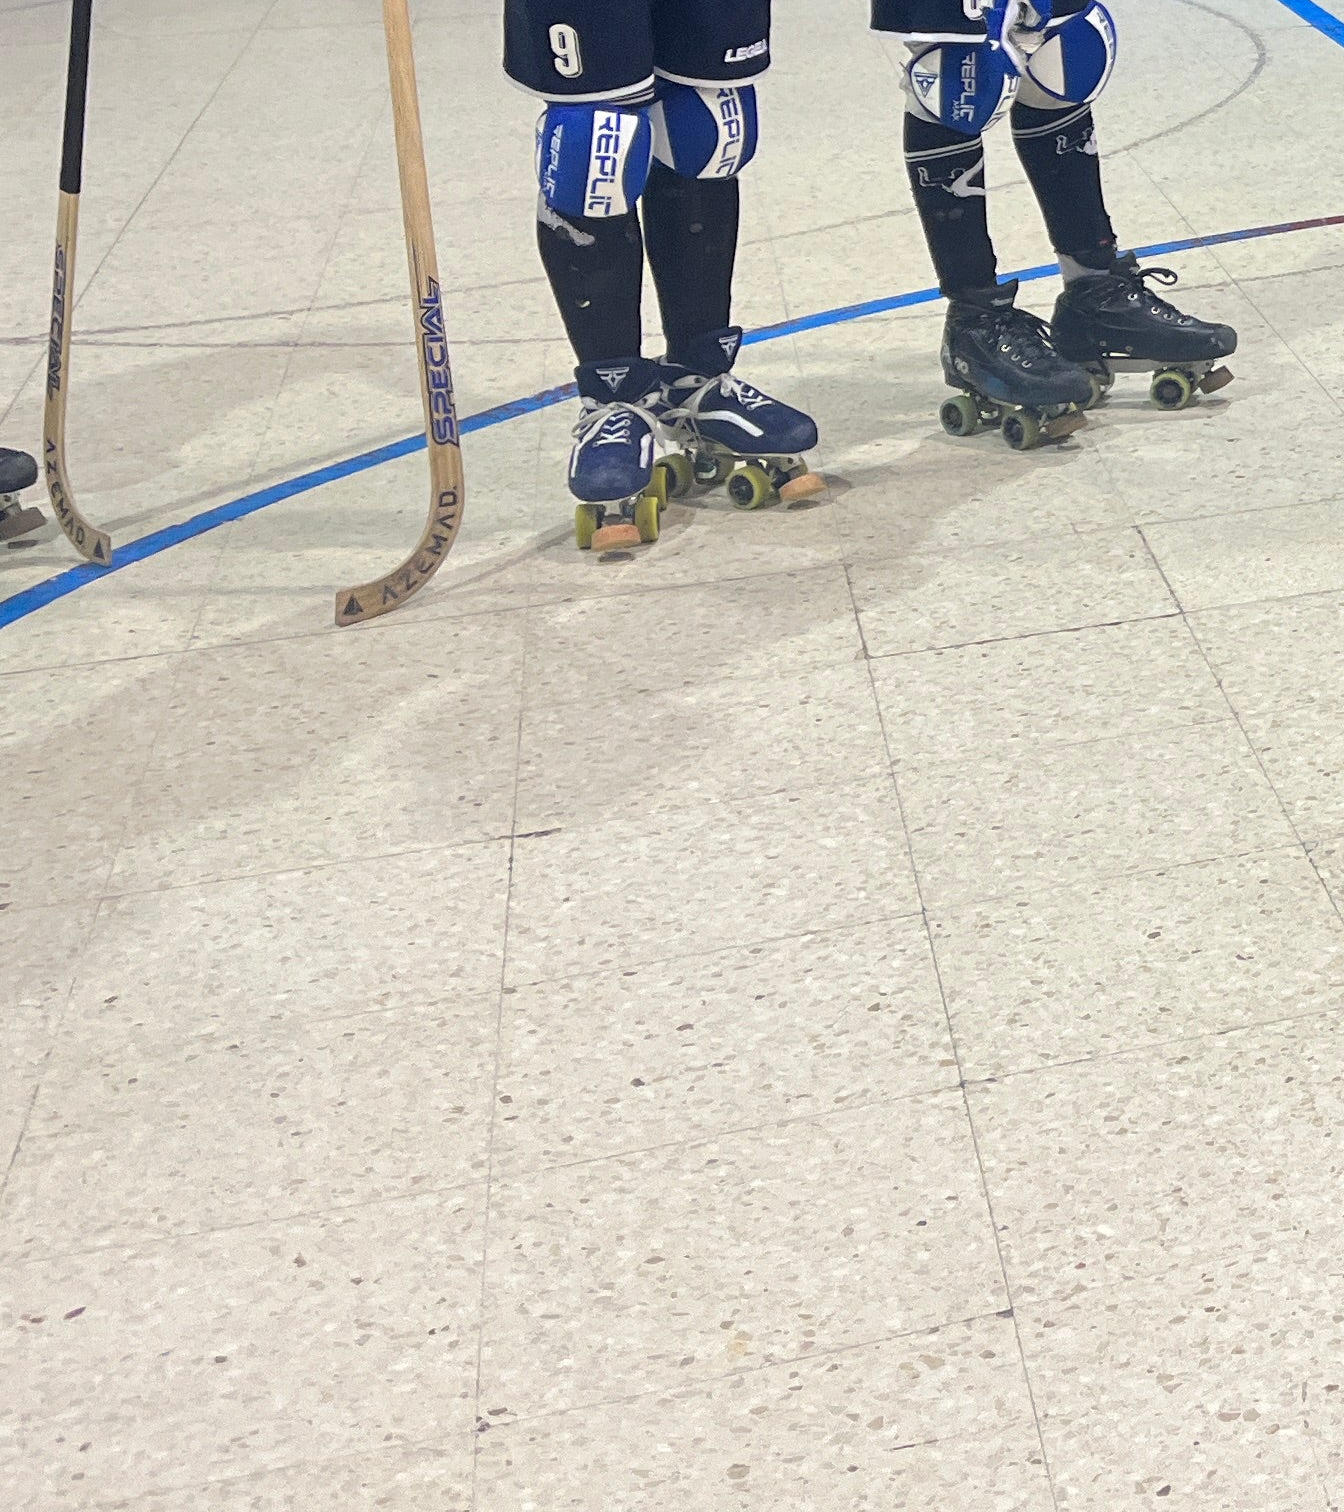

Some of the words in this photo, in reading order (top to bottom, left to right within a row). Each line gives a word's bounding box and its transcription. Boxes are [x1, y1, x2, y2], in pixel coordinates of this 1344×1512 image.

[549, 23, 583, 78] 9
[960, 51, 976, 123] REPLIC
[588, 112, 621, 217] REPLIC
[420, 276, 460, 448] SPECIAL
[381, 490, 458, 606] AZEMAD
